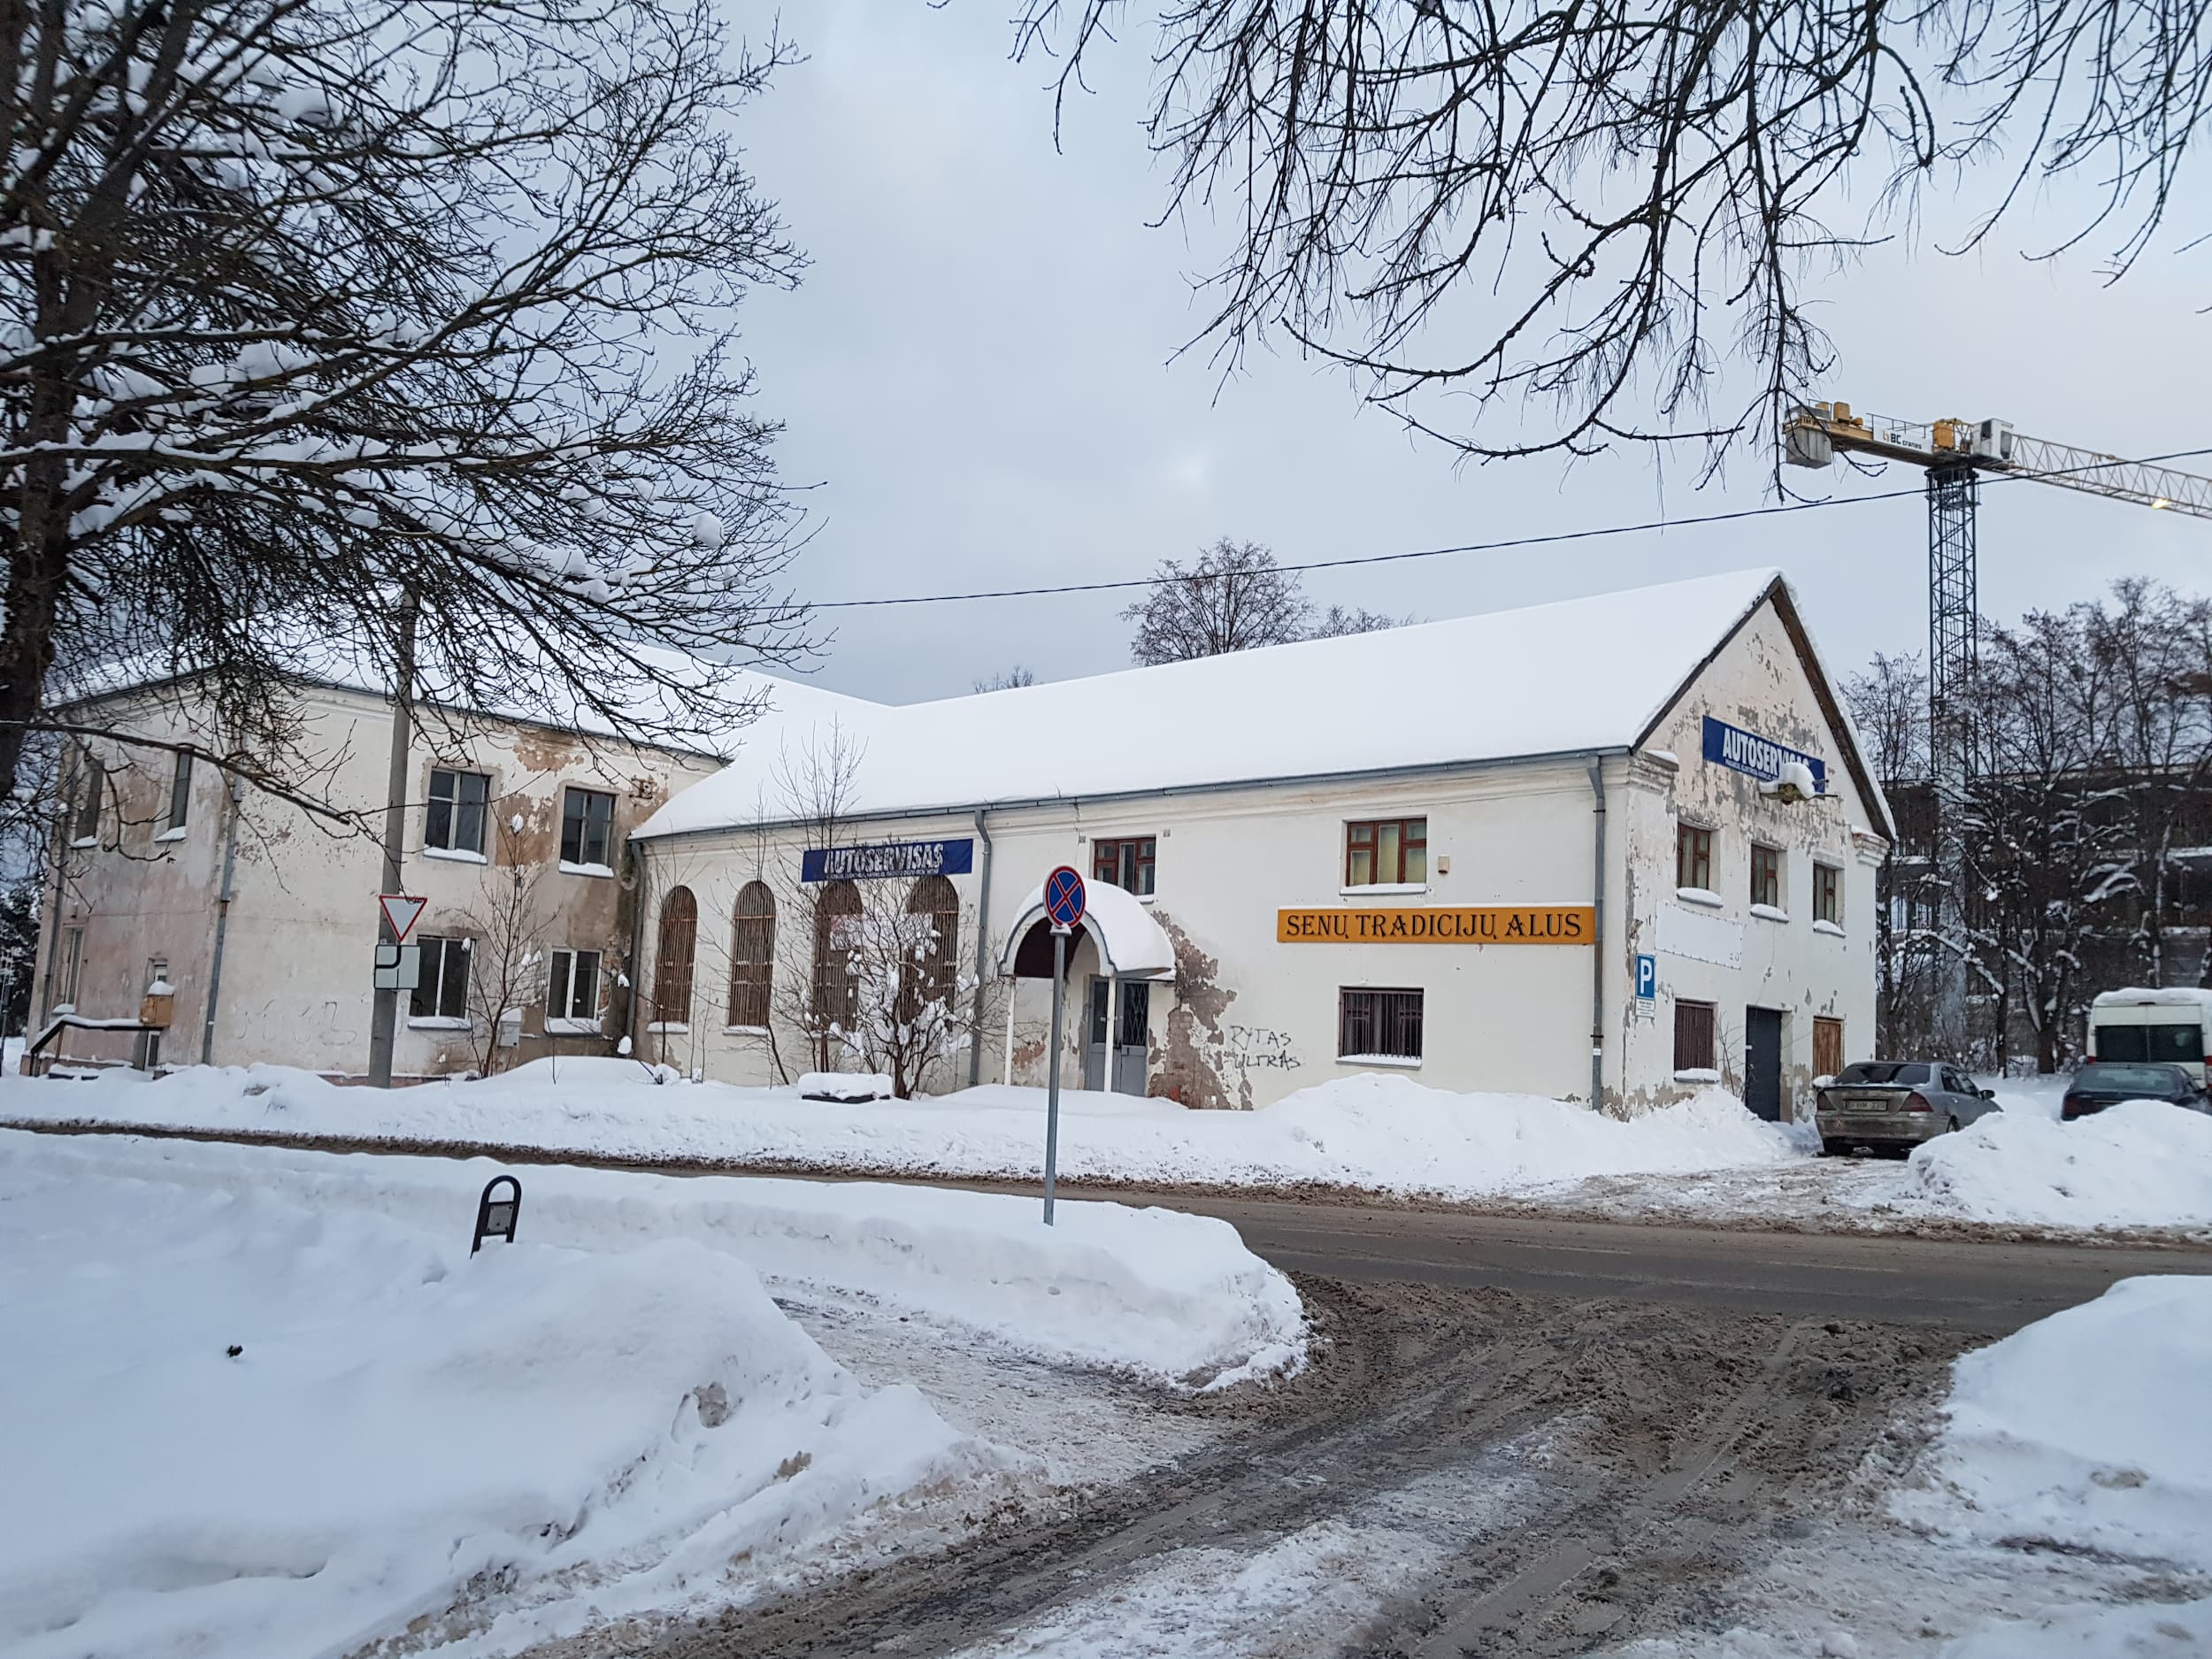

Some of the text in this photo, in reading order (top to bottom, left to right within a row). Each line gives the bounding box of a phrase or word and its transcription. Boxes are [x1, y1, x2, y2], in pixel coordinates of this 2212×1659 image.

[824, 843, 943, 873] AUTOSERVISAS
[1286, 912, 1581, 940] SENŲ TRADICIJŲ ALUS
[1640, 958, 1653, 994] P
[1234, 1049, 1301, 1071] ULTRAS
